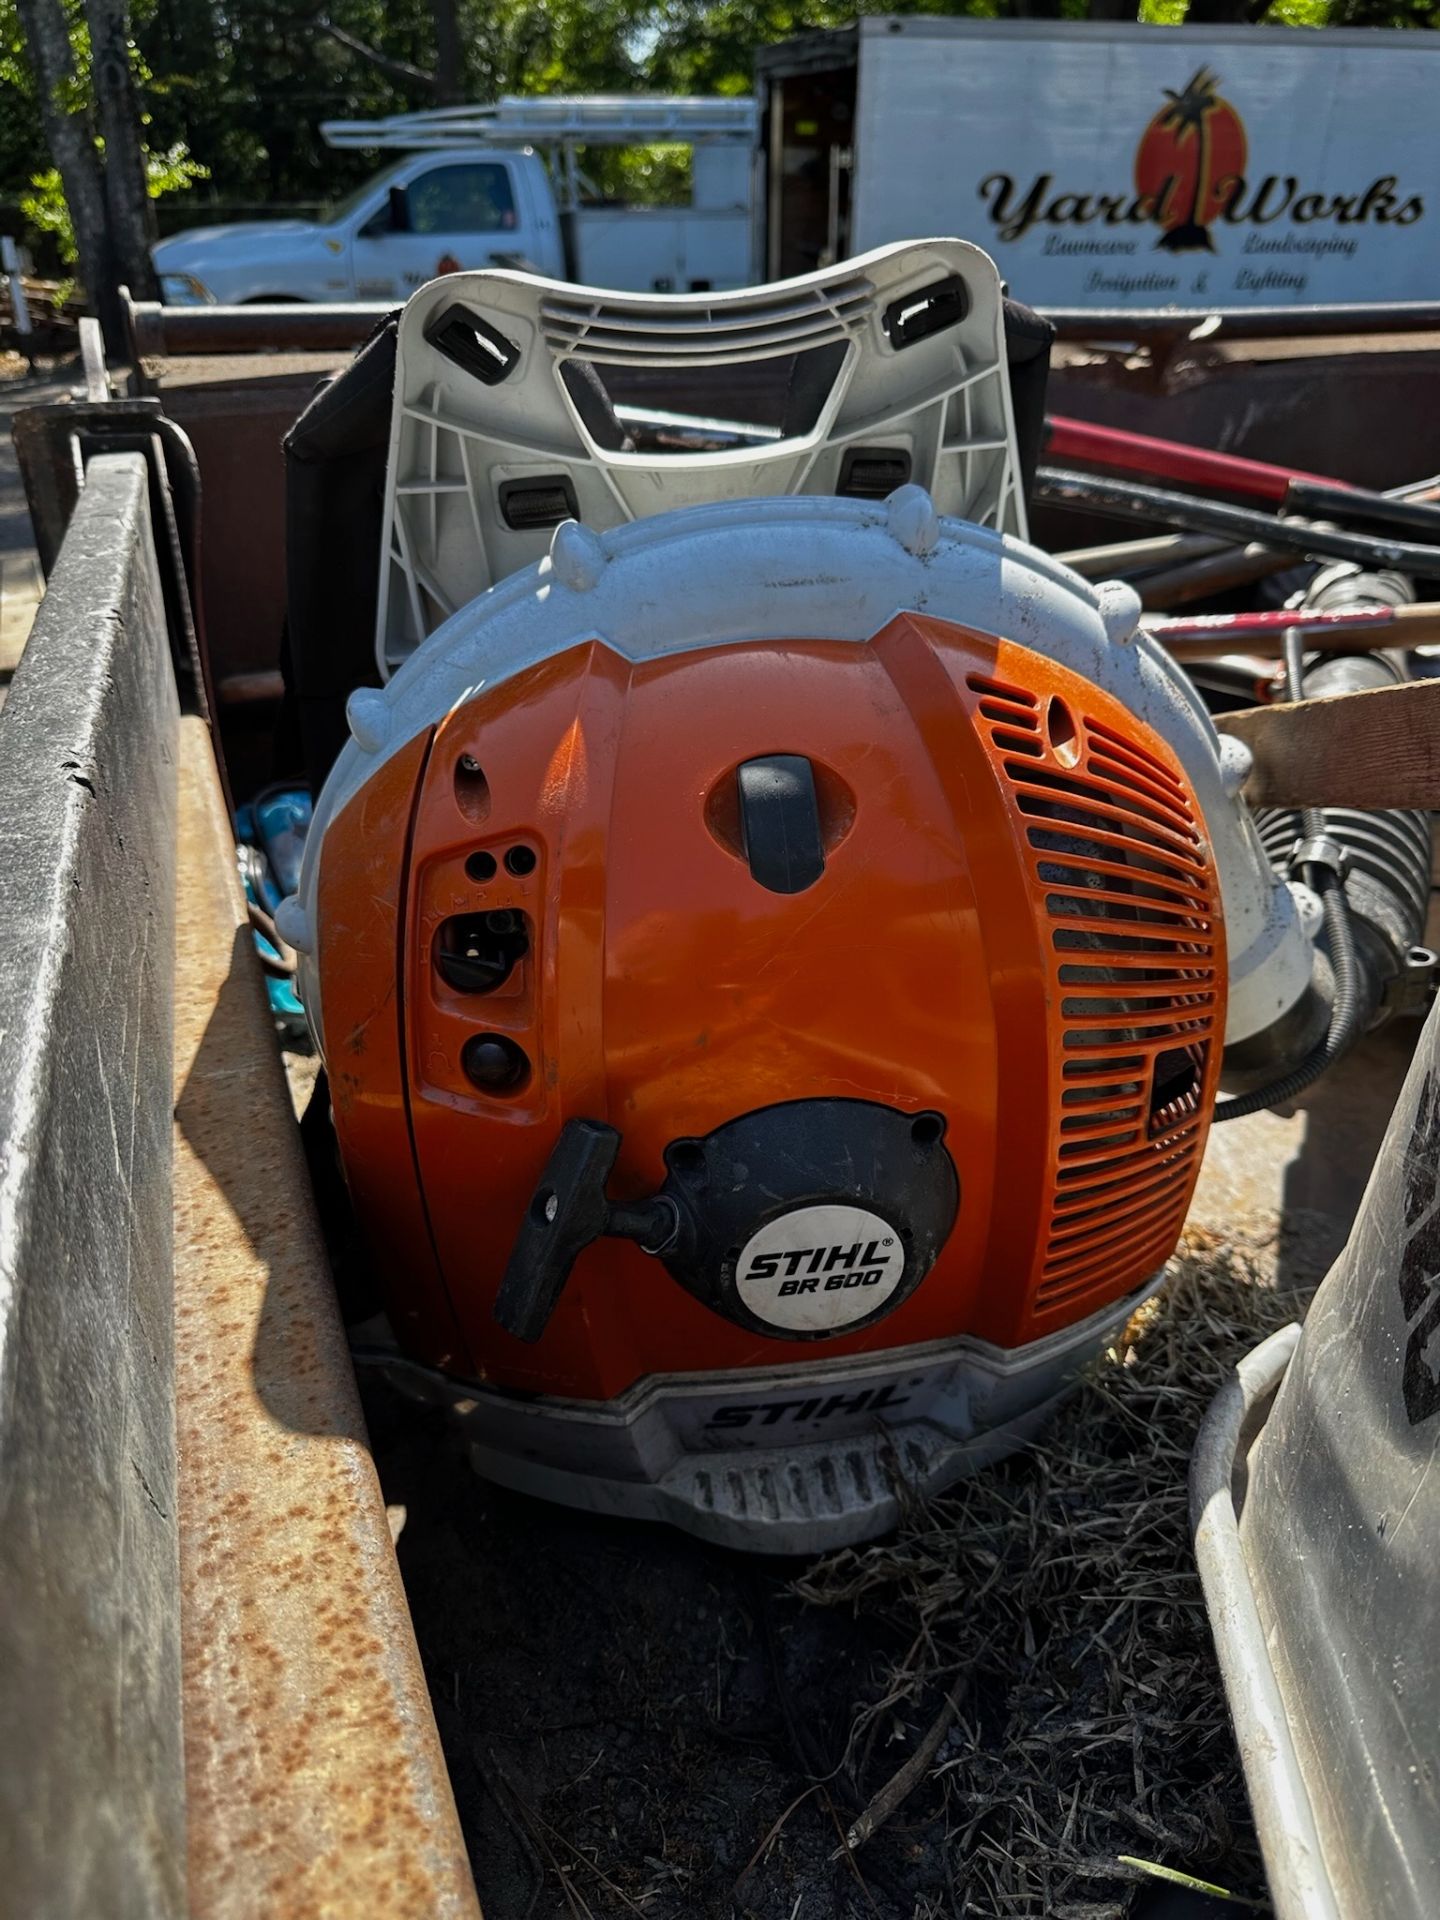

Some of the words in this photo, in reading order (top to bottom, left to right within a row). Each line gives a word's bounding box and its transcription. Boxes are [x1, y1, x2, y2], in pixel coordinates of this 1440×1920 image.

[977, 172, 1182, 243] Yard
[1214, 174, 1424, 225] Works
[777, 1278, 821, 1297] BR
[824, 1269, 884, 1291] 600
[704, 1385, 912, 1429] STIHL
